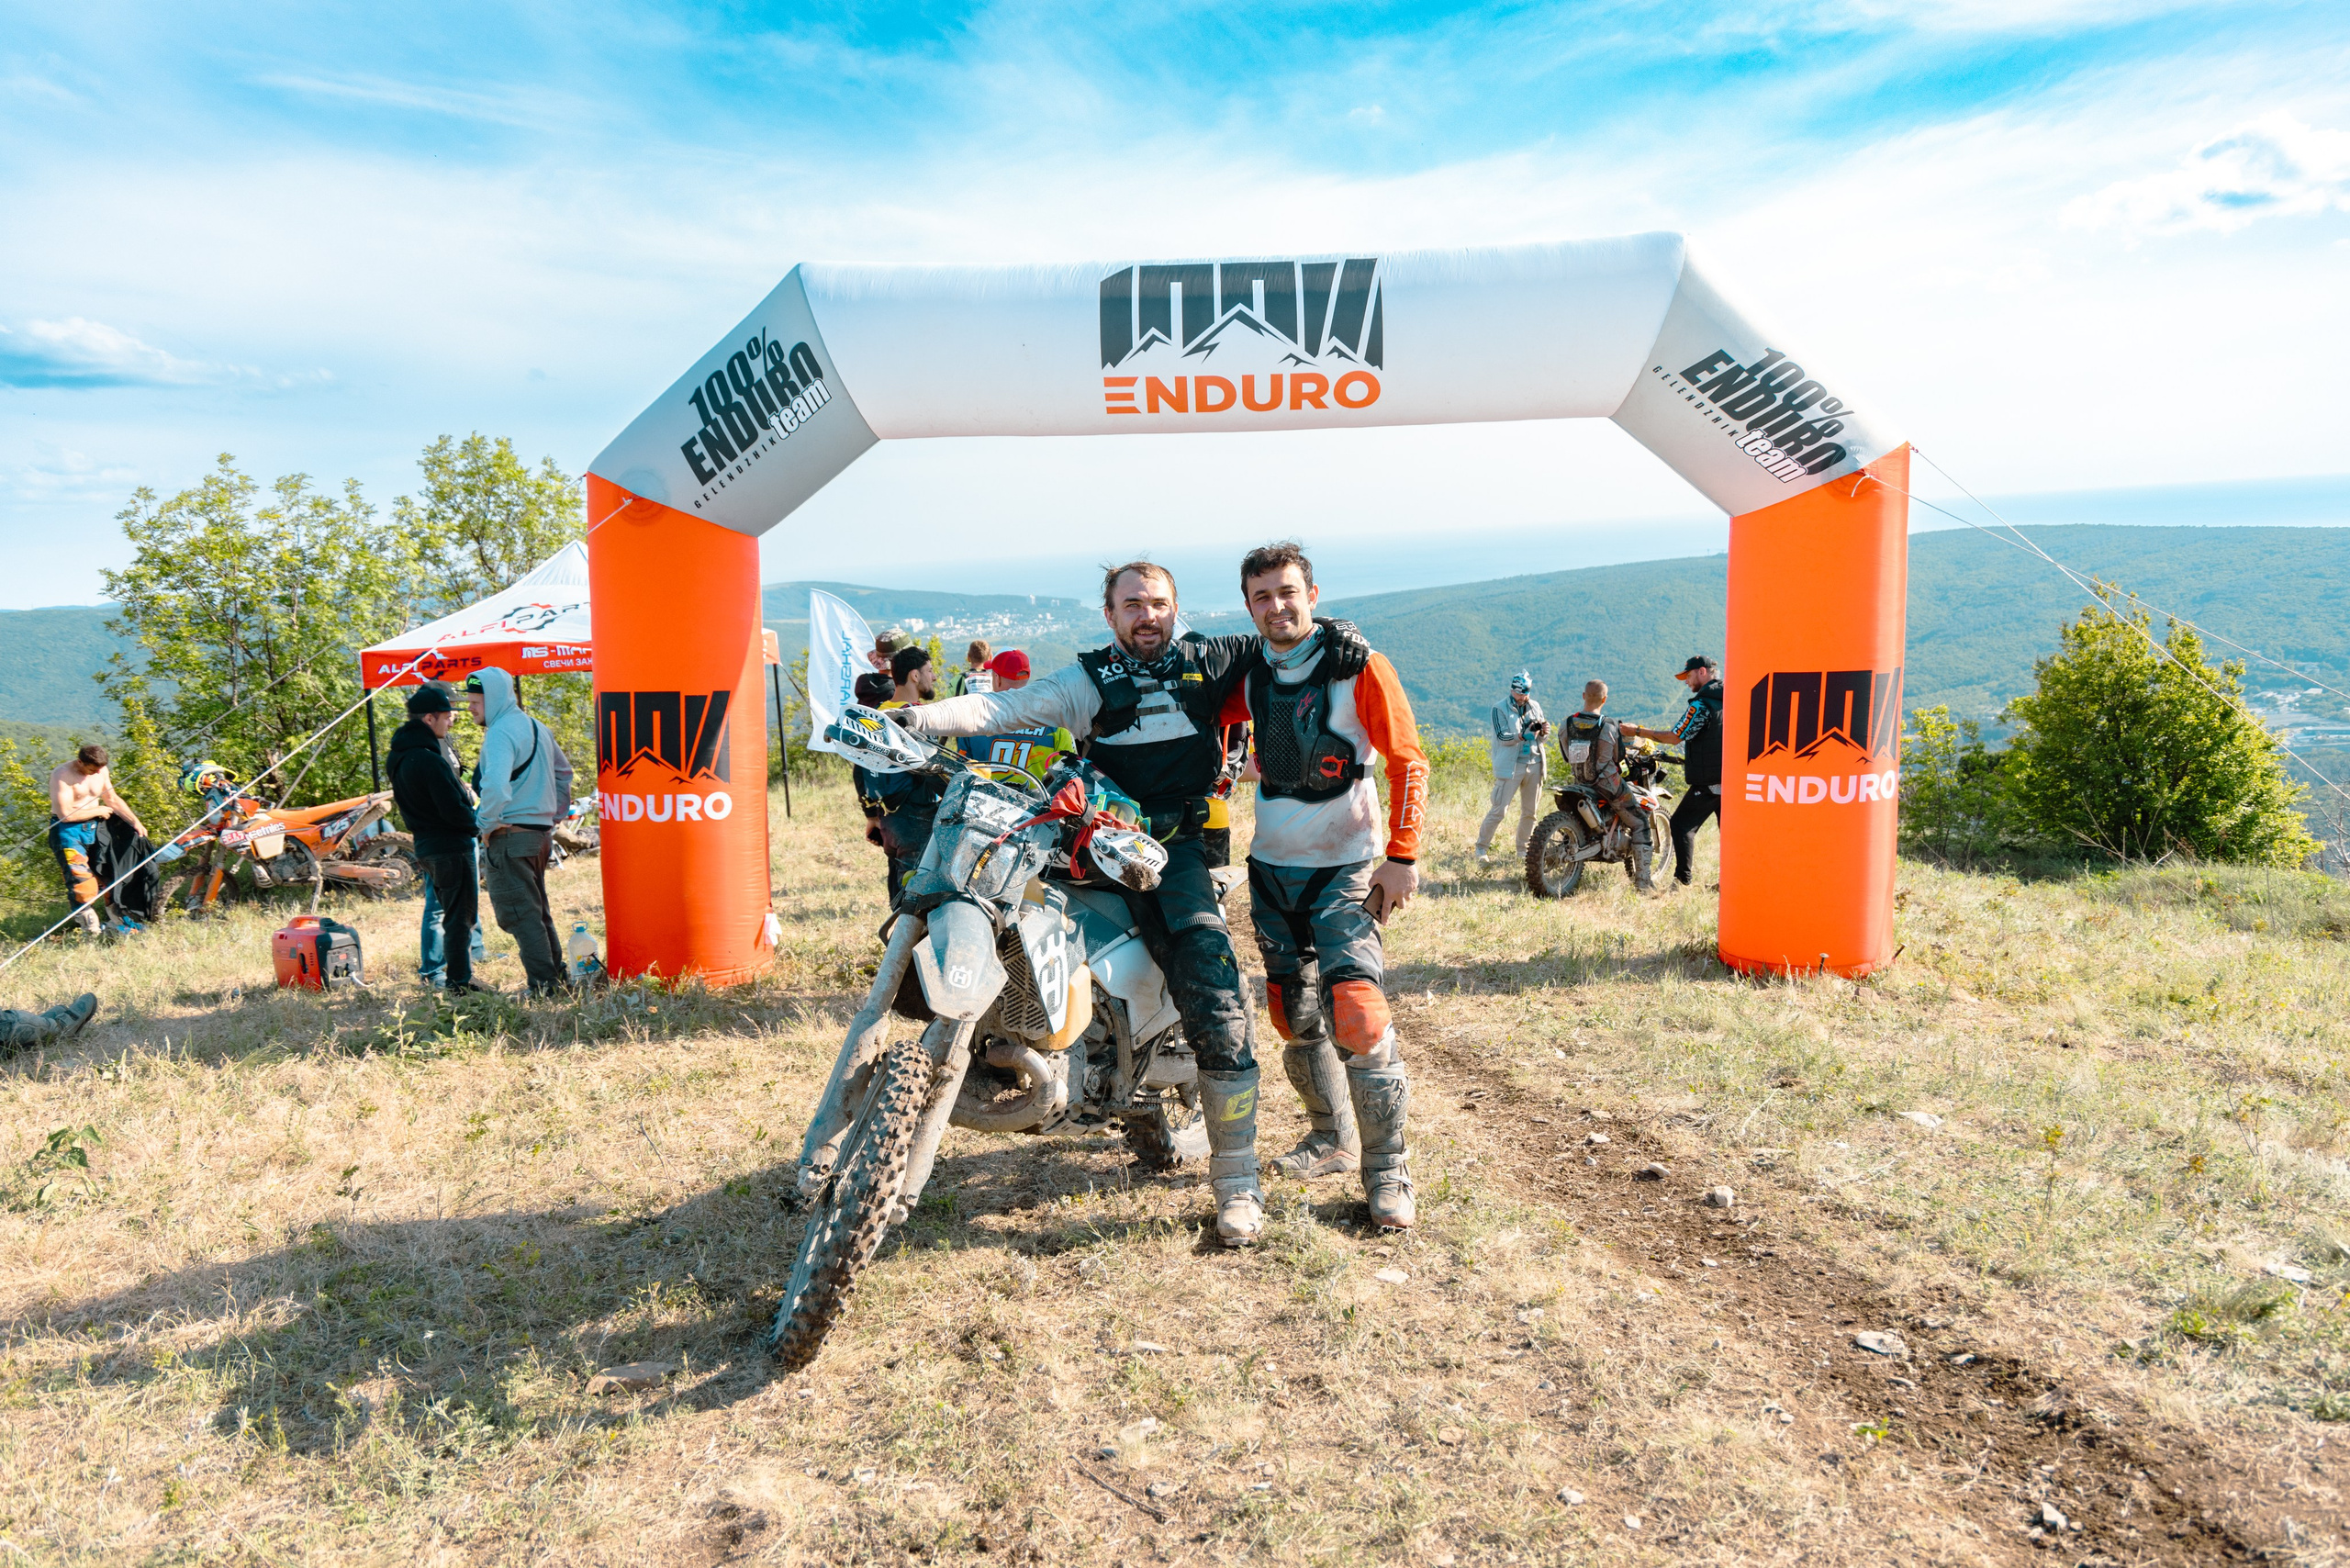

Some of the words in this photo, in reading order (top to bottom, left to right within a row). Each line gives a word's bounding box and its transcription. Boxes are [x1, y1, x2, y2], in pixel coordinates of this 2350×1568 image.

[688, 326, 784, 426] 100%
[1103, 370, 1382, 415] ENDURO
[1652, 365, 1738, 437] GELENDZHIK
[1745, 347, 1854, 438] 100%
[680, 342, 823, 487] ENDURO
[768, 377, 832, 440] team
[1679, 349, 1847, 476] ENDURO
[694, 436, 776, 509] GELENDZHIK
[1735, 426, 1807, 484] team
[543, 658, 574, 668] СВЕЧИ
[1343, 631, 1371, 647] FOX
[990, 739, 1035, 775] 01
[1745, 769, 1896, 804] ENDURO
[972, 849, 992, 879] ELEMENT
